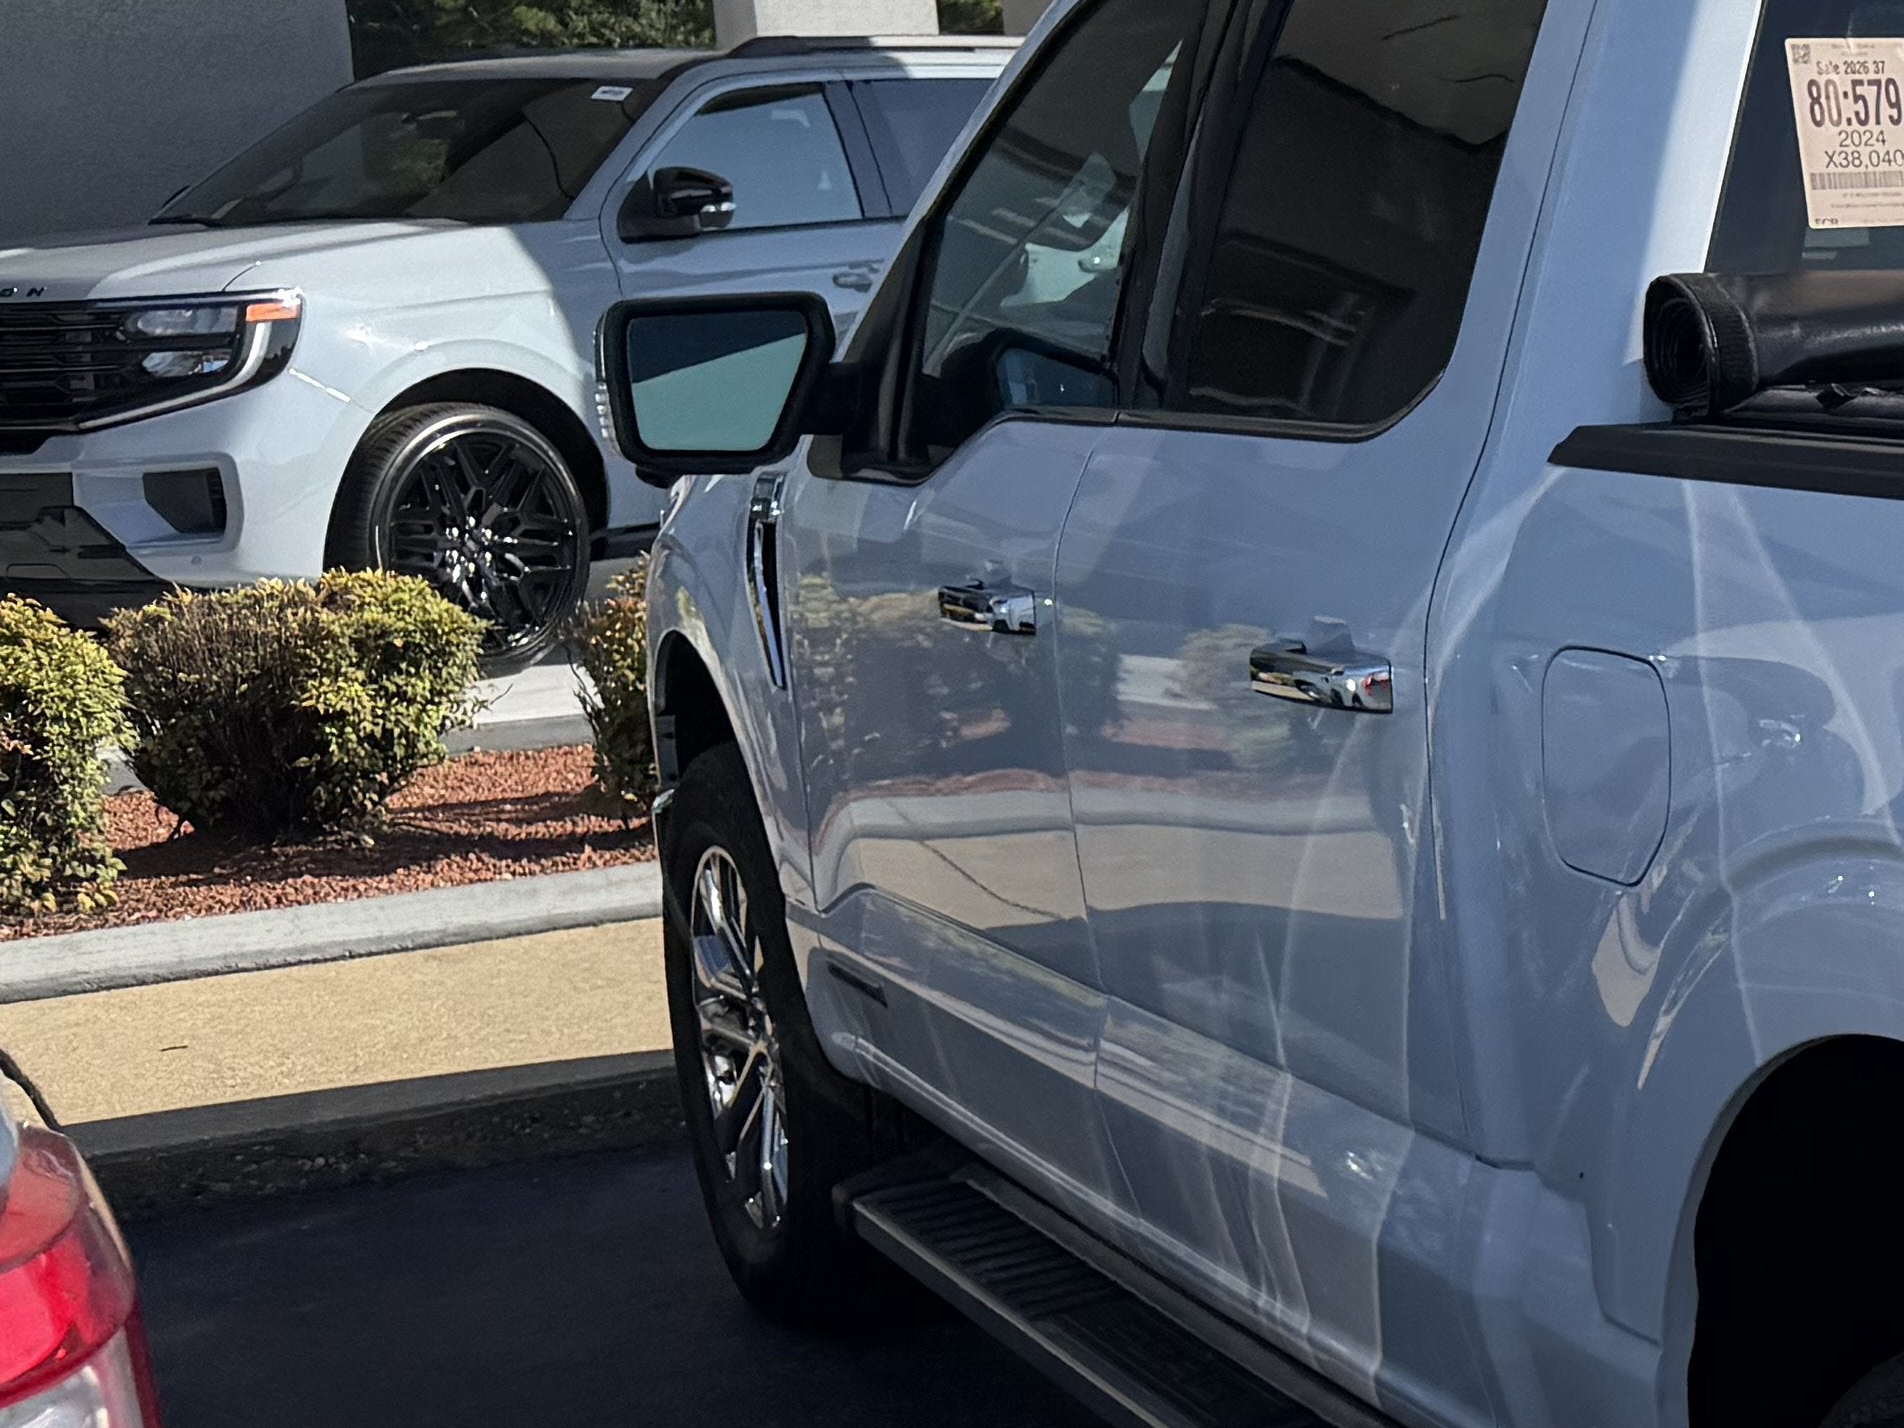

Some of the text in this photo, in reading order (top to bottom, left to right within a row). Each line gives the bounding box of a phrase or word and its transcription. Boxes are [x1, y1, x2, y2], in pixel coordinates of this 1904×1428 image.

[1807, 78, 1903, 127] 80:579
[1838, 130, 1887, 147] 2024
[1824, 149, 1904, 170] X38,040
